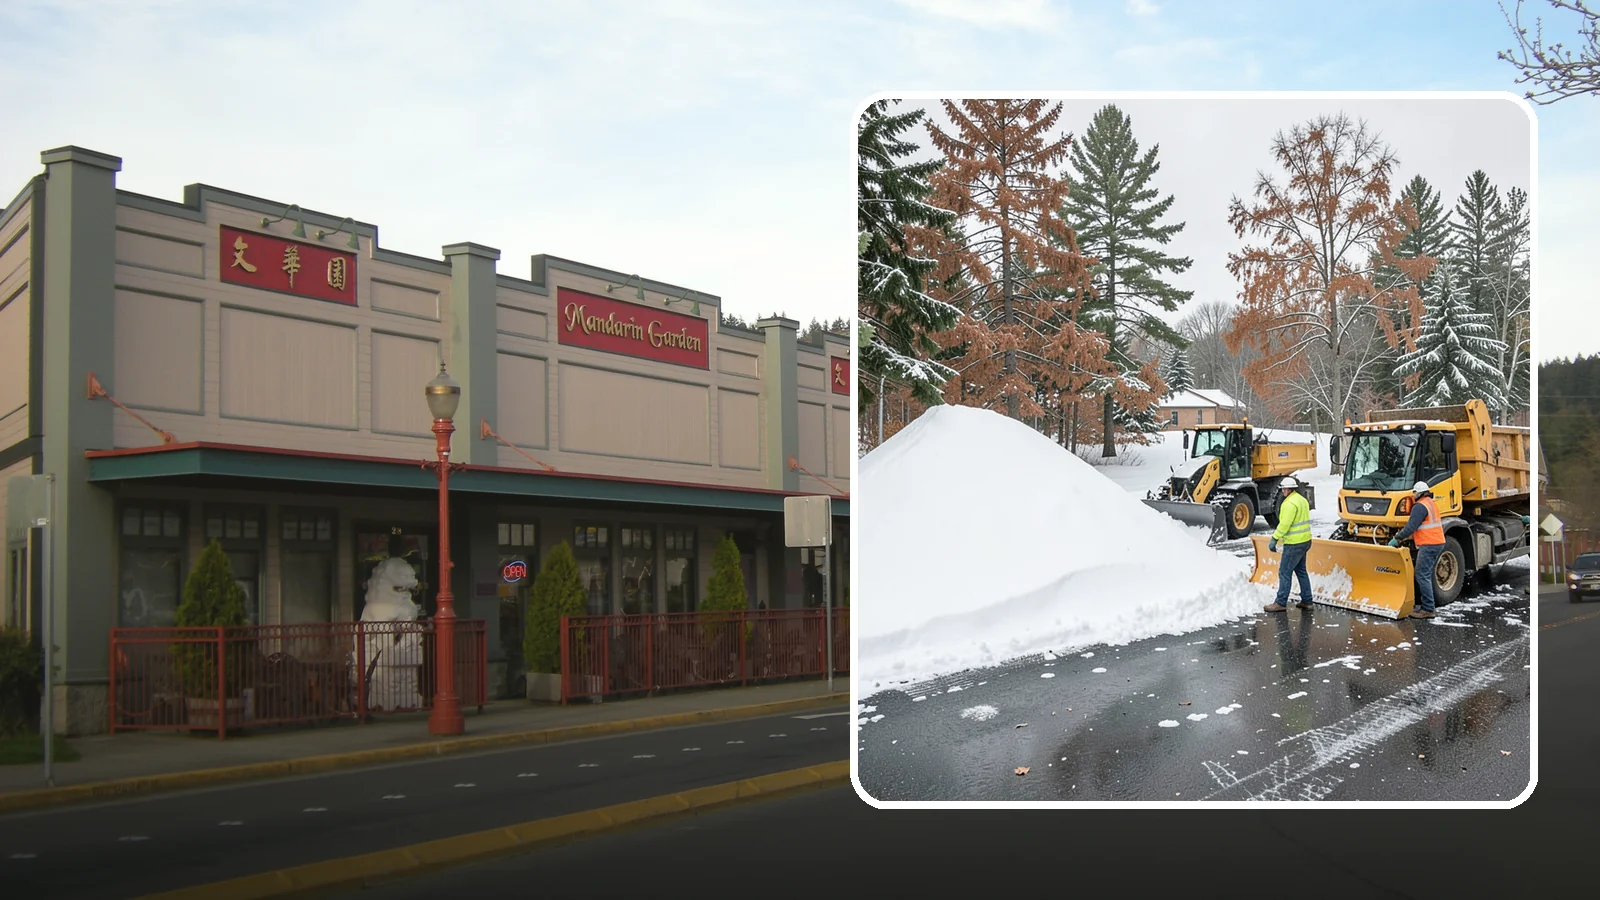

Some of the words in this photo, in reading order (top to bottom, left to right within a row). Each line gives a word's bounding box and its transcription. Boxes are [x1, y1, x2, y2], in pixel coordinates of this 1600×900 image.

[231, 235, 346, 291] 文華園
[565, 302, 643, 340] Mandarin
[648, 320, 701, 352] Garden
[503, 565, 527, 577] OPEN
